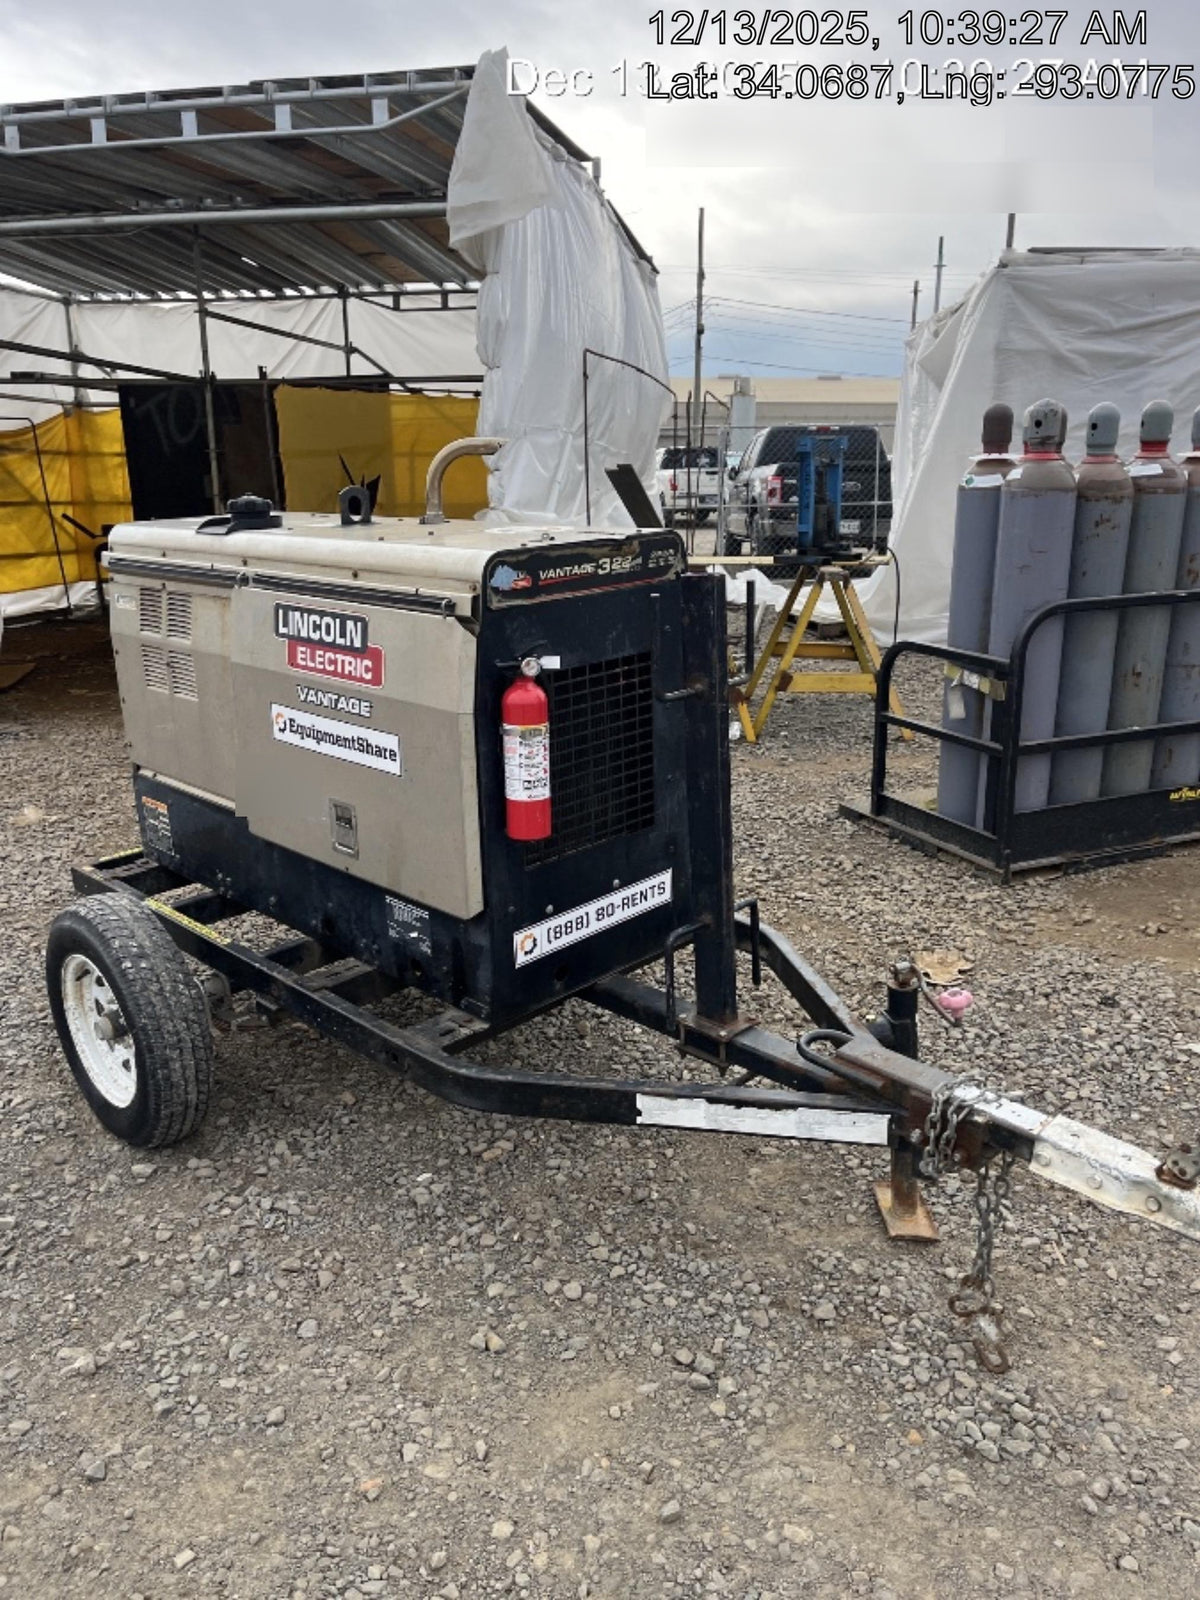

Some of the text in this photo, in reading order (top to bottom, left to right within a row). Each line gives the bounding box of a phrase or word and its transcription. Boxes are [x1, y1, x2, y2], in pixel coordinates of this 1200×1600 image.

[278, 608, 362, 648] LINCOLN
[297, 646, 373, 680] ELECTRIC
[296, 684, 374, 717] VANTAGE
[288, 717, 398, 762] EquipmentShare
[546, 880, 667, 945] (888) 80-RENTS
